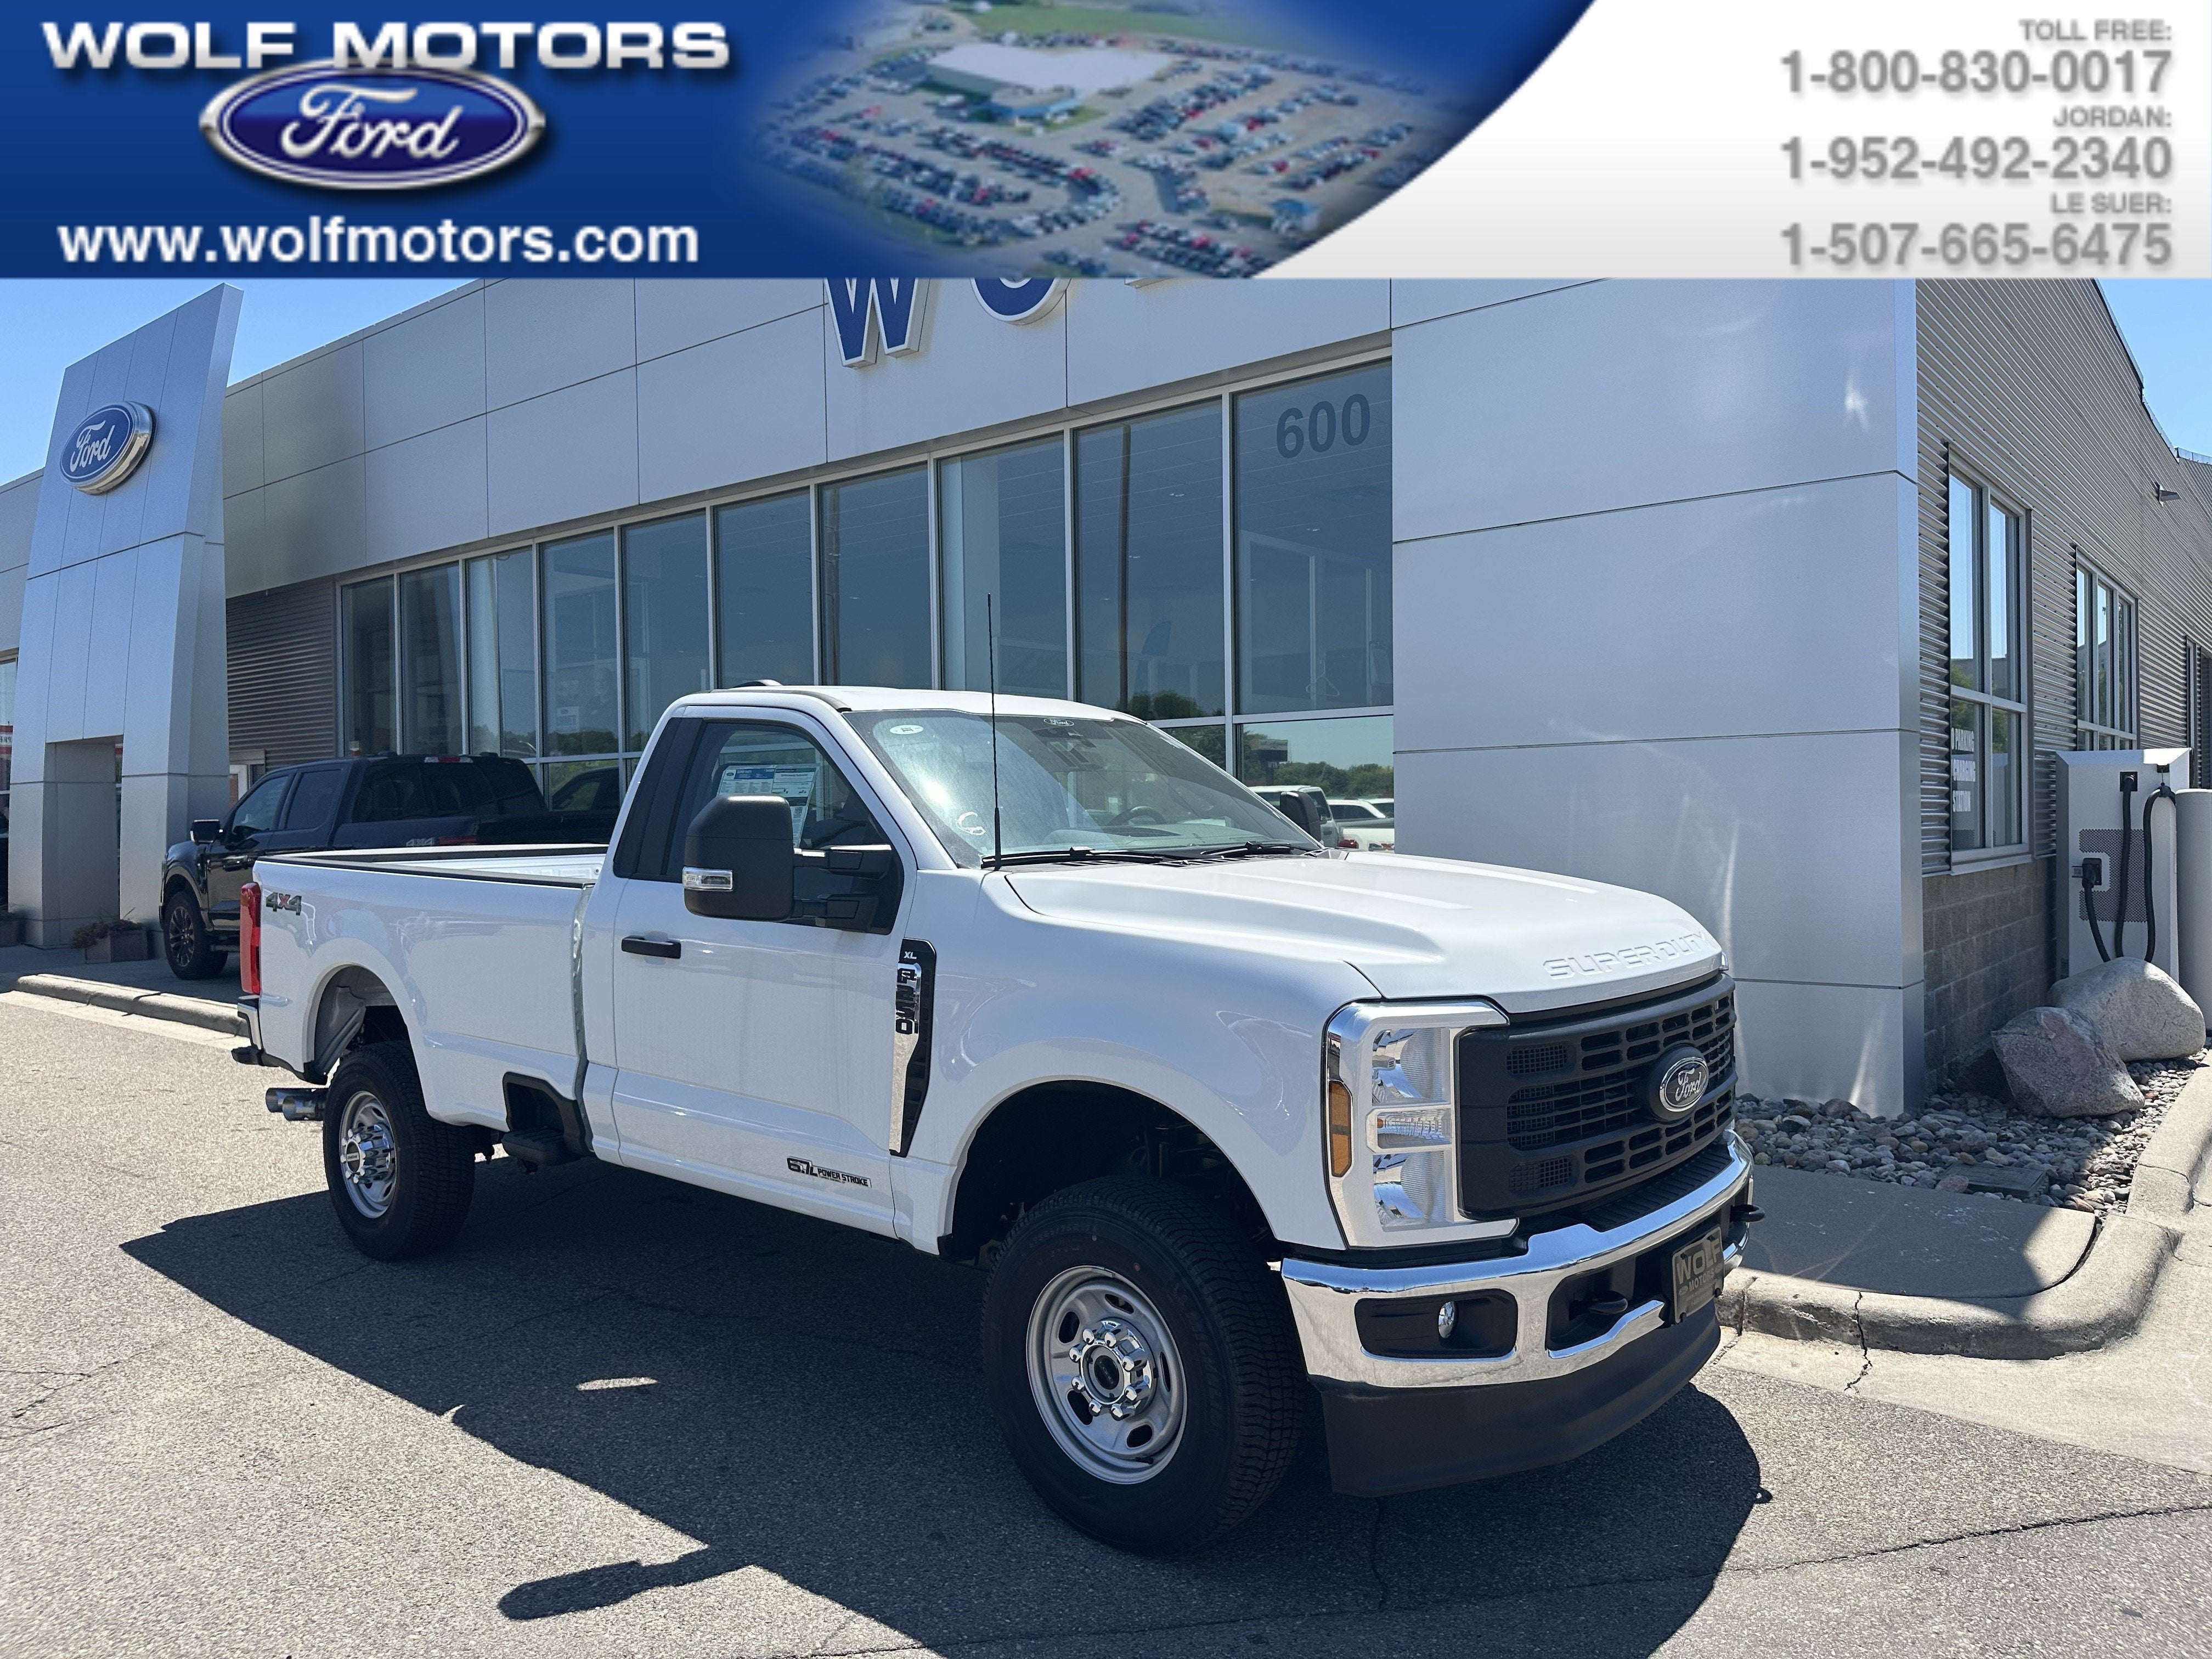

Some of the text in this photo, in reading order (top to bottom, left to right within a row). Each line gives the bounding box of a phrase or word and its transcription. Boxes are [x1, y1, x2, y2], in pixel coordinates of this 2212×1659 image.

[1276, 393, 1371, 459] 600
[70, 420, 116, 472] Ford
[904, 951, 917, 960] XL
[1543, 945, 1662, 980] SUPER
[1674, 1067, 1702, 1102] Ford
[787, 1157, 818, 1177] 6.7L
[817, 1168, 841, 1180] POWER
[841, 1173, 869, 1187] STROKE
[1676, 1237, 1721, 1285] WOLF
[1688, 1268, 1716, 1293] MOTORS
